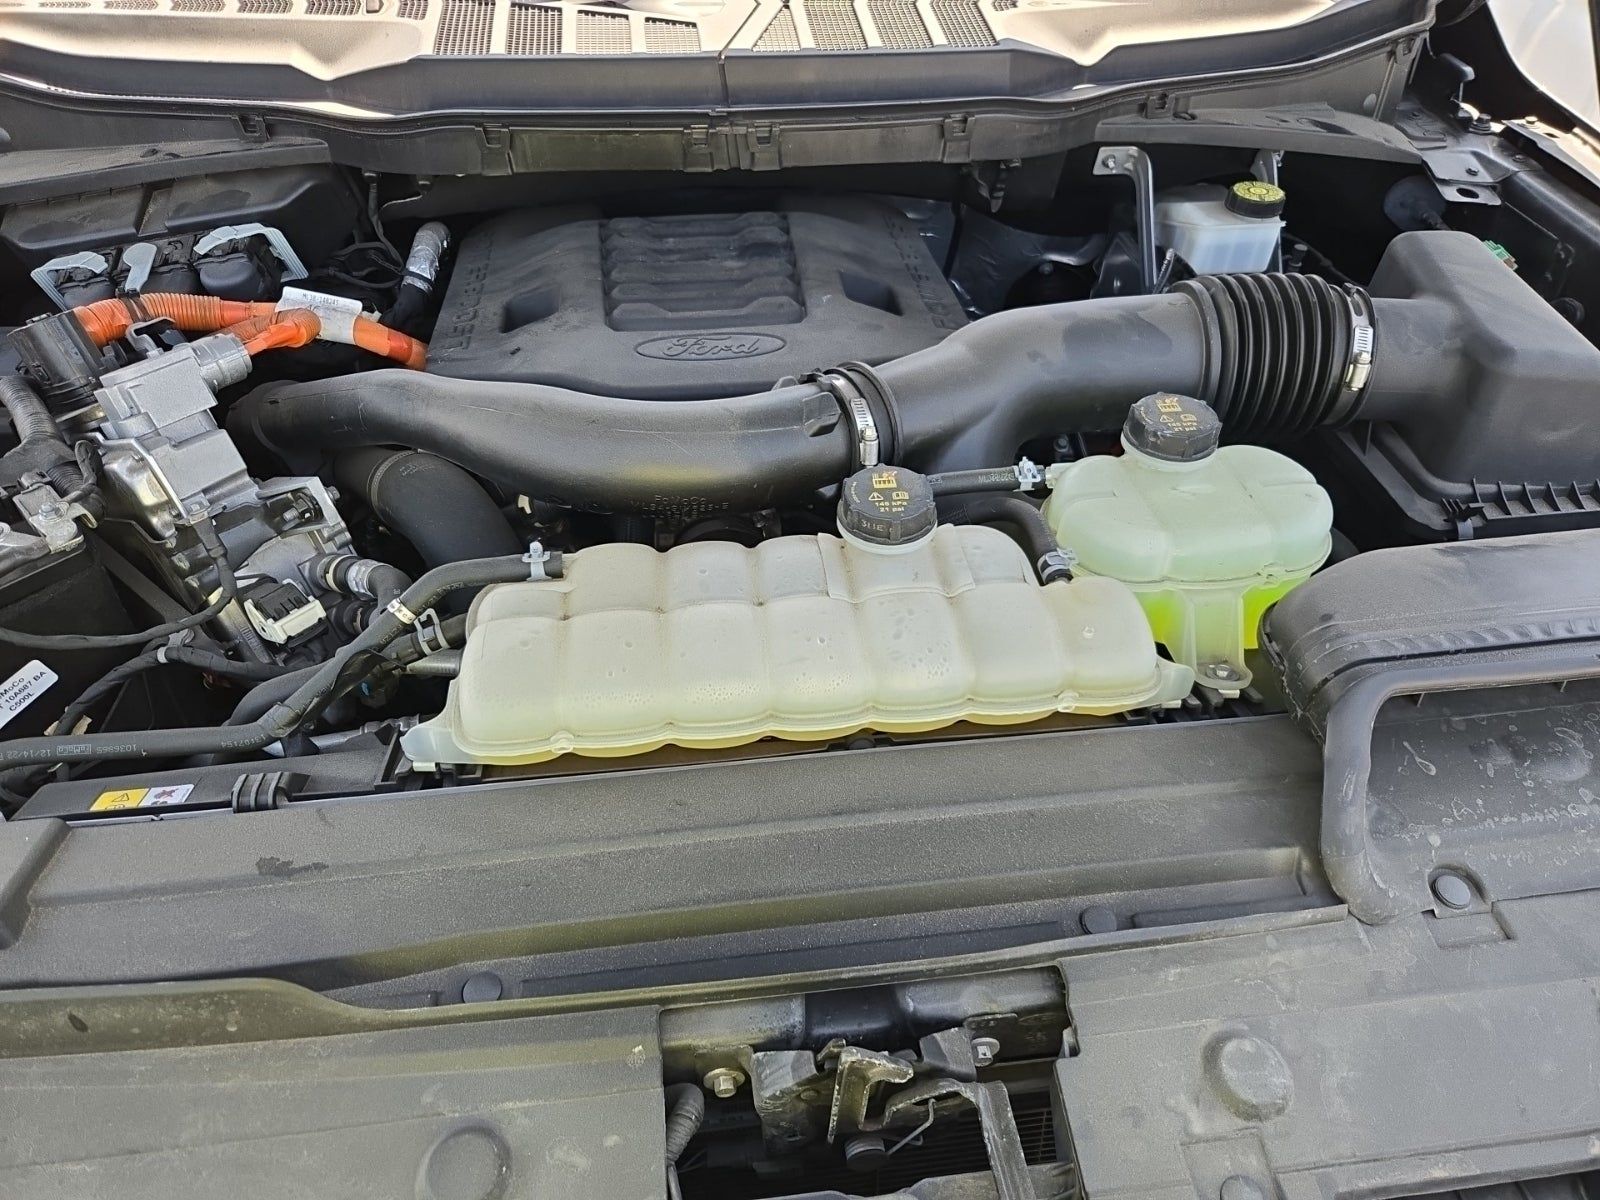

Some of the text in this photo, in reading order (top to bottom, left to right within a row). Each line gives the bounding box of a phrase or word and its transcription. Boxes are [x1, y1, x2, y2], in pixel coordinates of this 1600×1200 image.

[662, 335, 760, 357] Ford
[32, 671, 47, 682] BA
[9, 692, 35, 712] C500L
